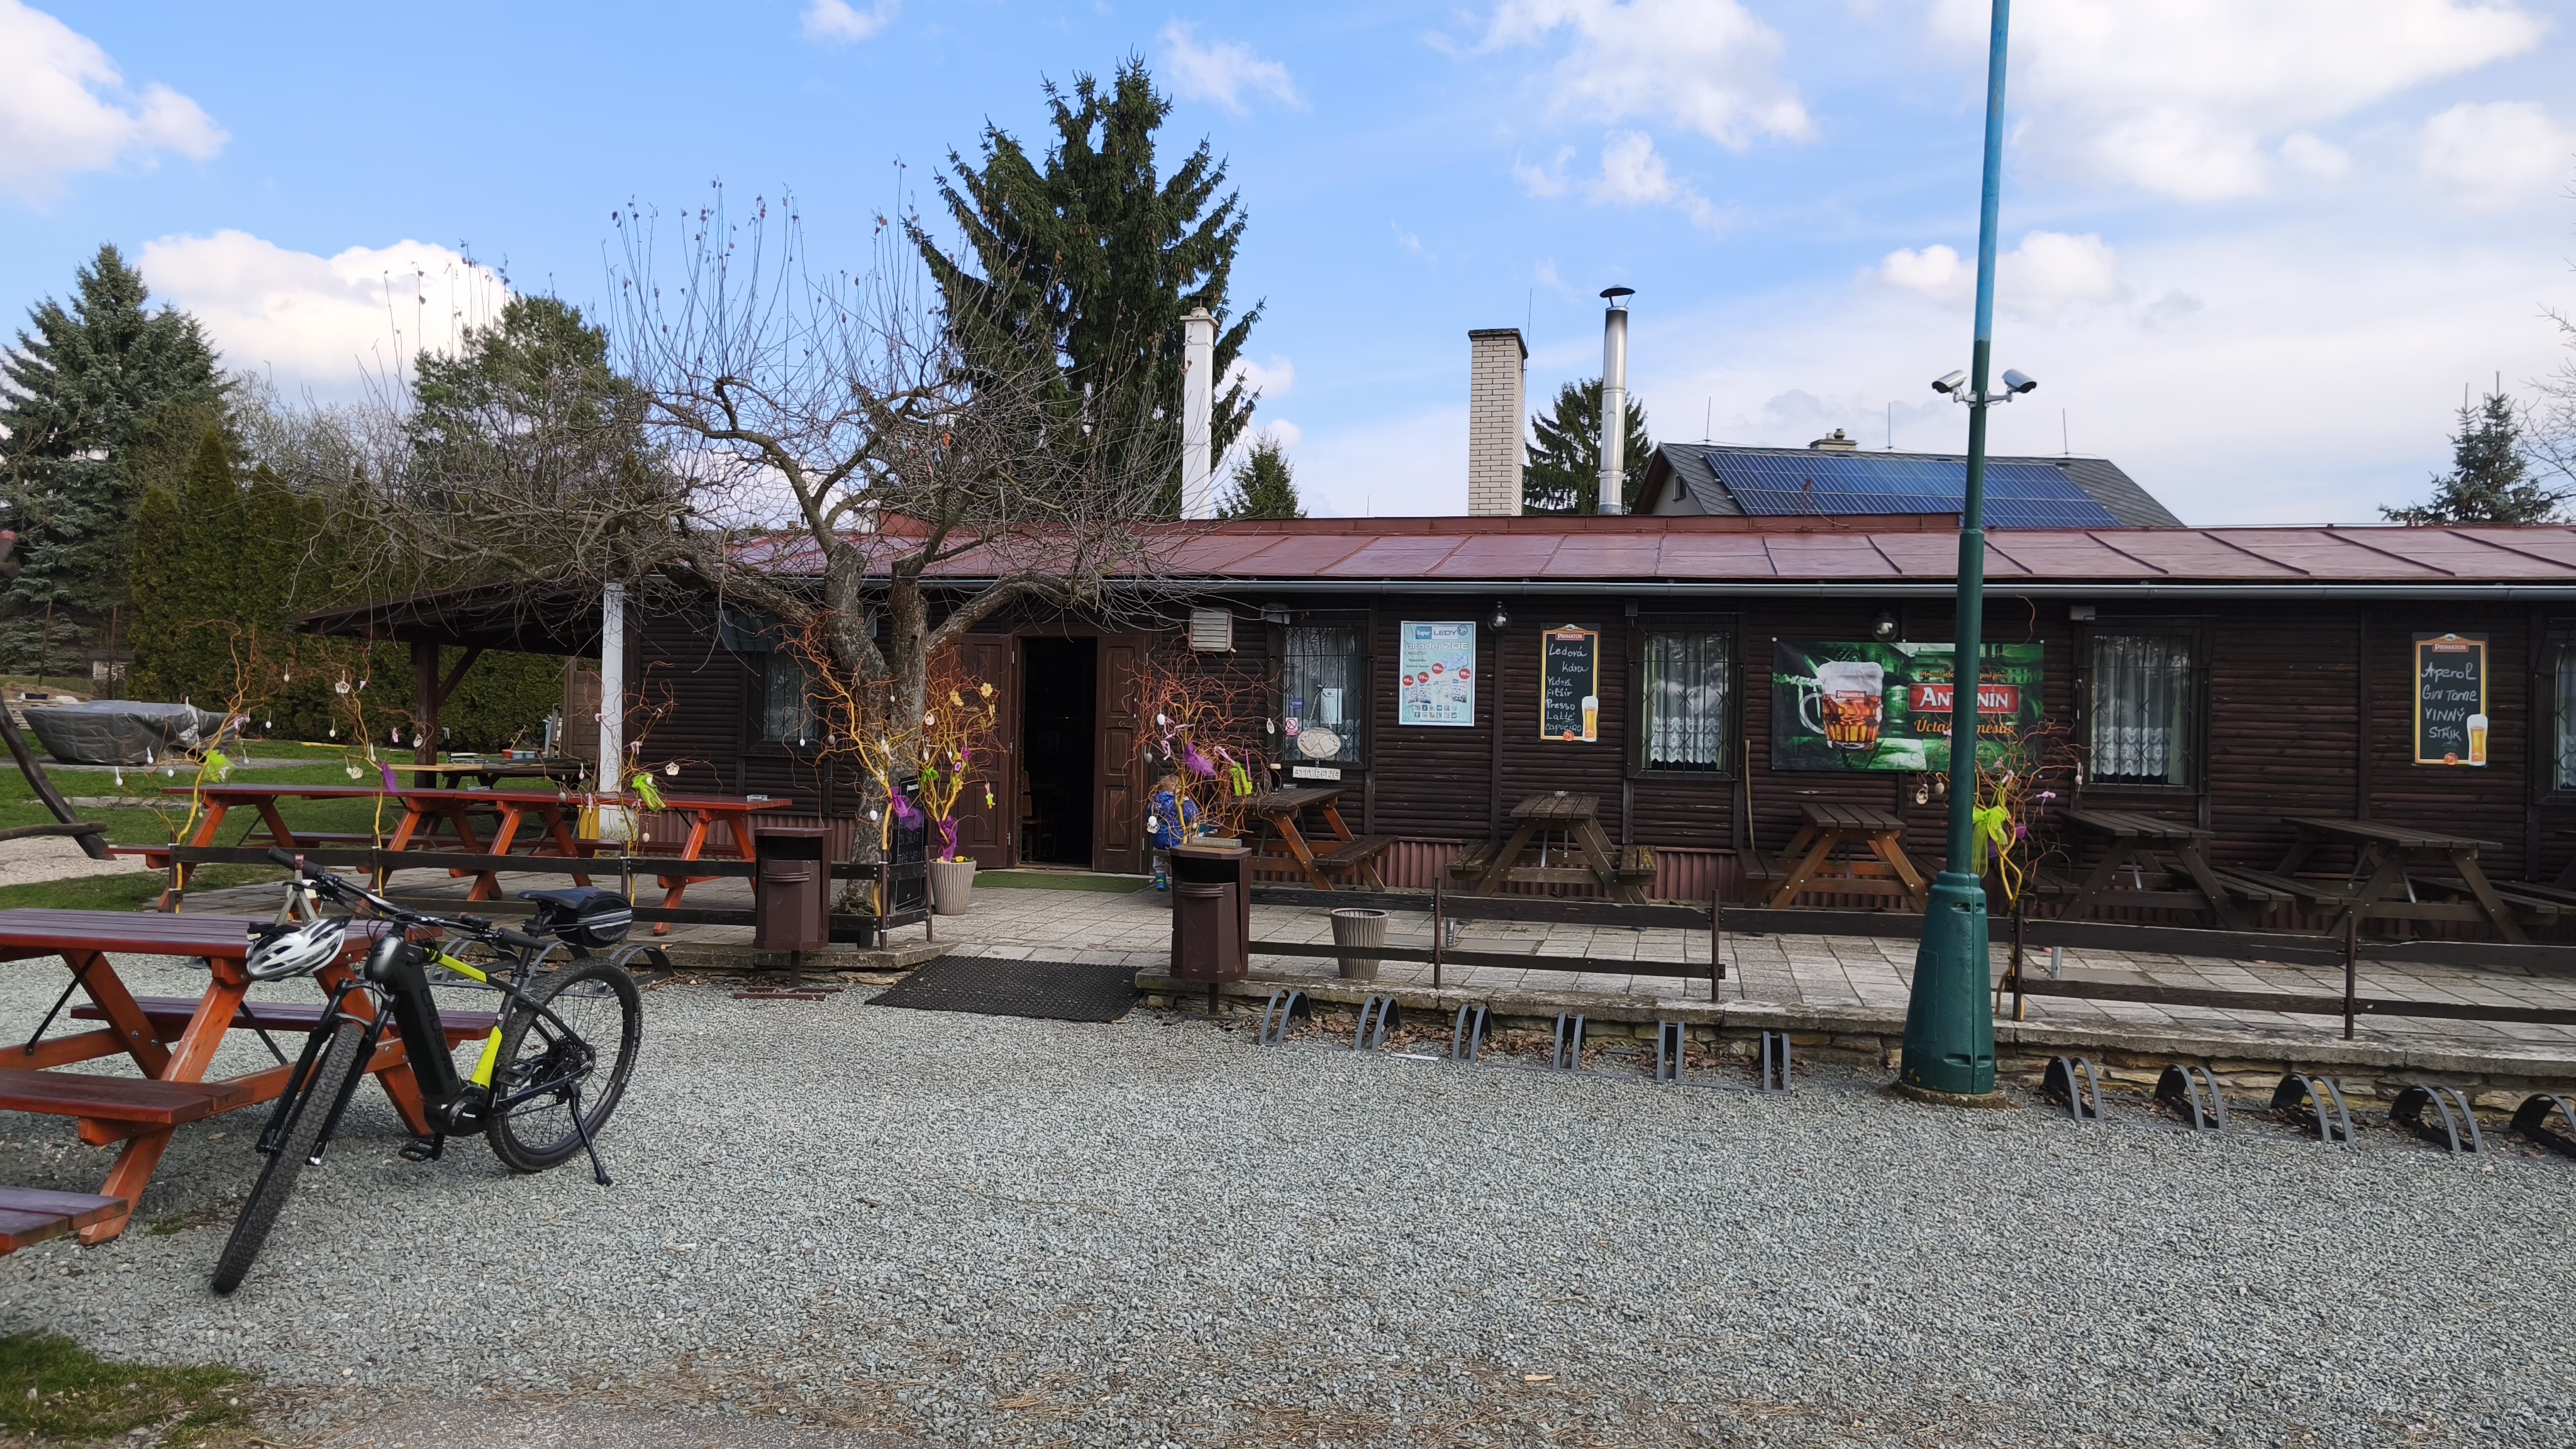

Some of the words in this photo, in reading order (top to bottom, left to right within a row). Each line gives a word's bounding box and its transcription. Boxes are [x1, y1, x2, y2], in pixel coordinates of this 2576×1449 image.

[1405, 642, 1441, 651] prodej
[1443, 642, 1469, 650] ZDE
[1549, 643, 1587, 657] Ledová
[2421, 661, 2477, 683] Aperol
[1545, 698, 1575, 711] Presso
[2424, 707, 2465, 722] VINNÝ
[621, 1039, 638, 1084] SMART
